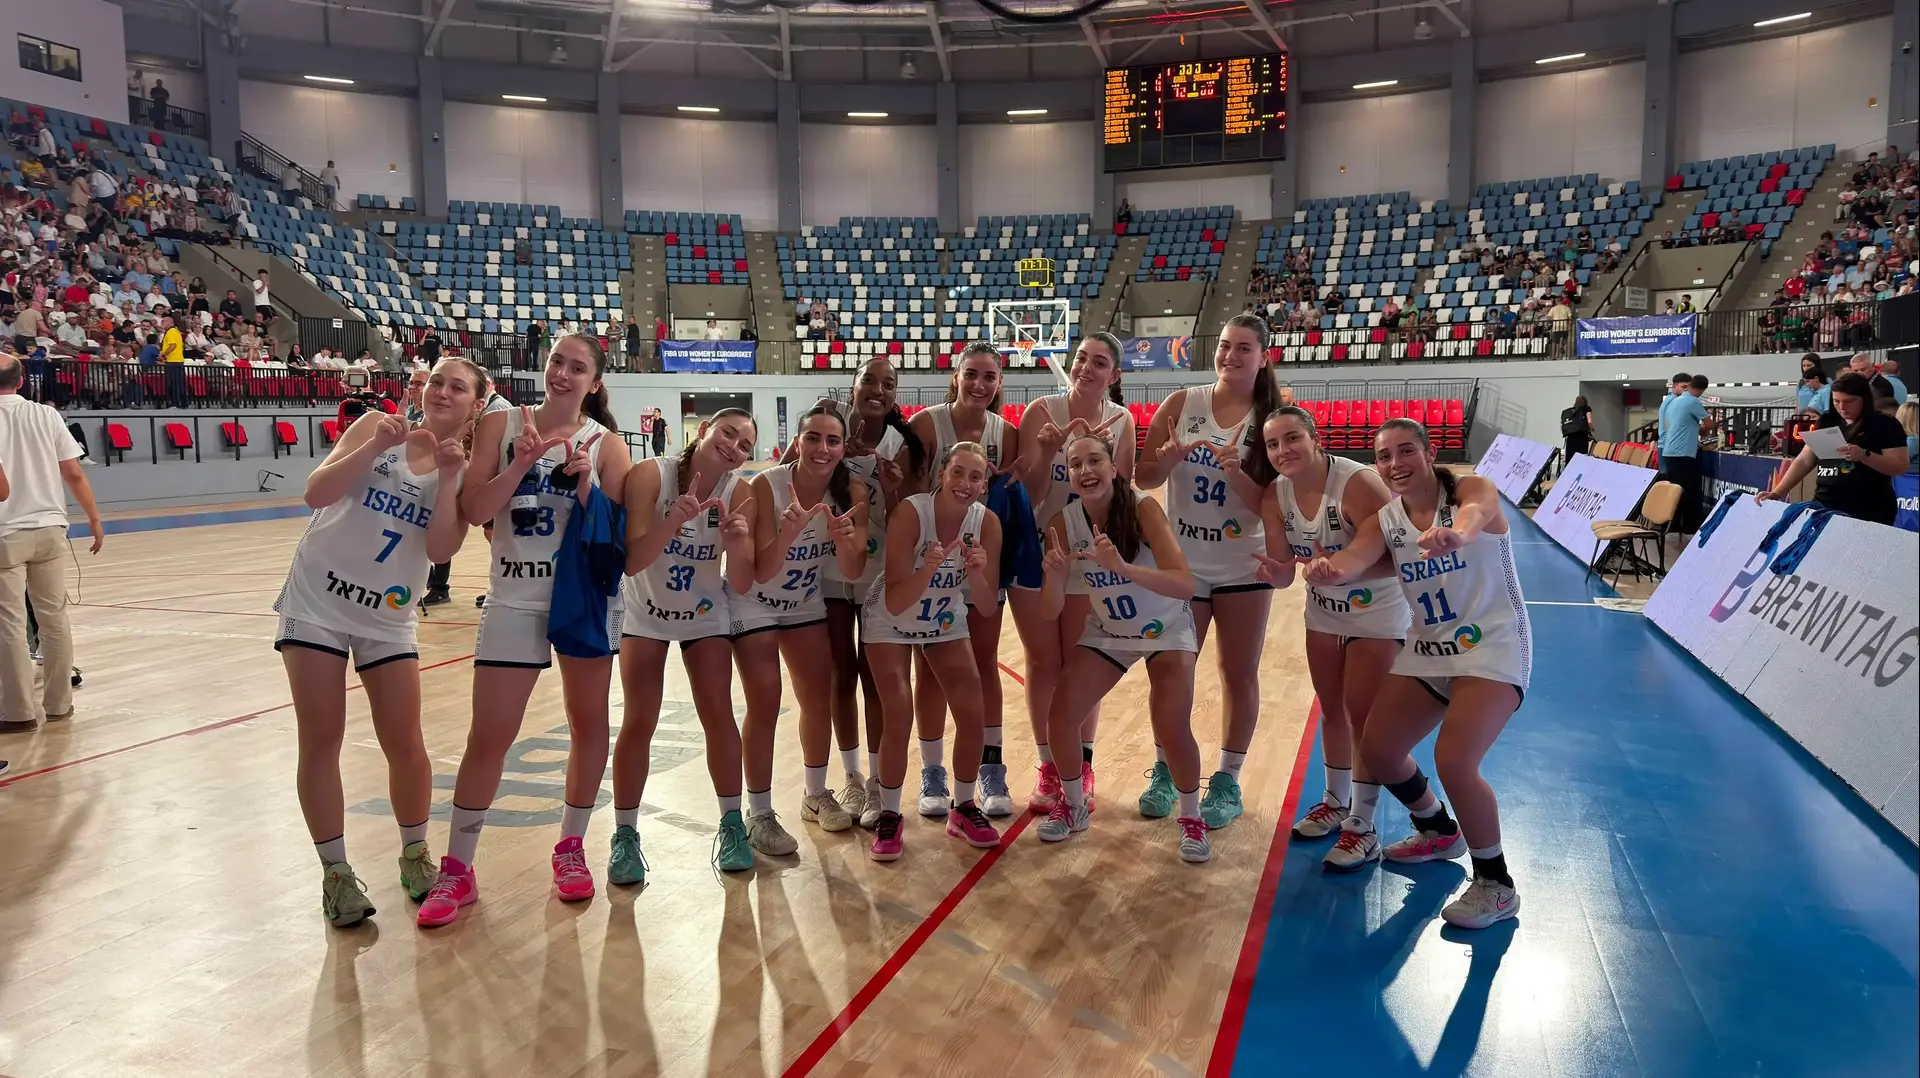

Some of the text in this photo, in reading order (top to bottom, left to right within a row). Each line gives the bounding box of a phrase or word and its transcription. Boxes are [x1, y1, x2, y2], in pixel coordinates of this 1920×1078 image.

[1580, 327, 1692, 339] FIBA U18 WOMEN'S EUROBASKET
[518, 497, 530, 506] 23
[1194, 476, 1226, 507] 34
[1566, 486, 1607, 520] BRENNTAG
[363, 487, 432, 530] ISRAE
[1178, 518, 1221, 542] הראל
[374, 528, 403, 563] 7
[664, 539, 718, 561] RAEL
[500, 557, 552, 578] הראל
[782, 565, 819, 591] 25
[918, 568, 968, 588] RAEL
[1400, 550, 1466, 583] SRAEL
[326, 571, 383, 610] הראל
[1311, 586, 1350, 612] הראל
[647, 599, 695, 622] הראל
[916, 596, 952, 622] 12
[1102, 595, 1137, 620] 10
[1417, 588, 1457, 626] 11
[1749, 574, 1919, 688] BRENNTAG
